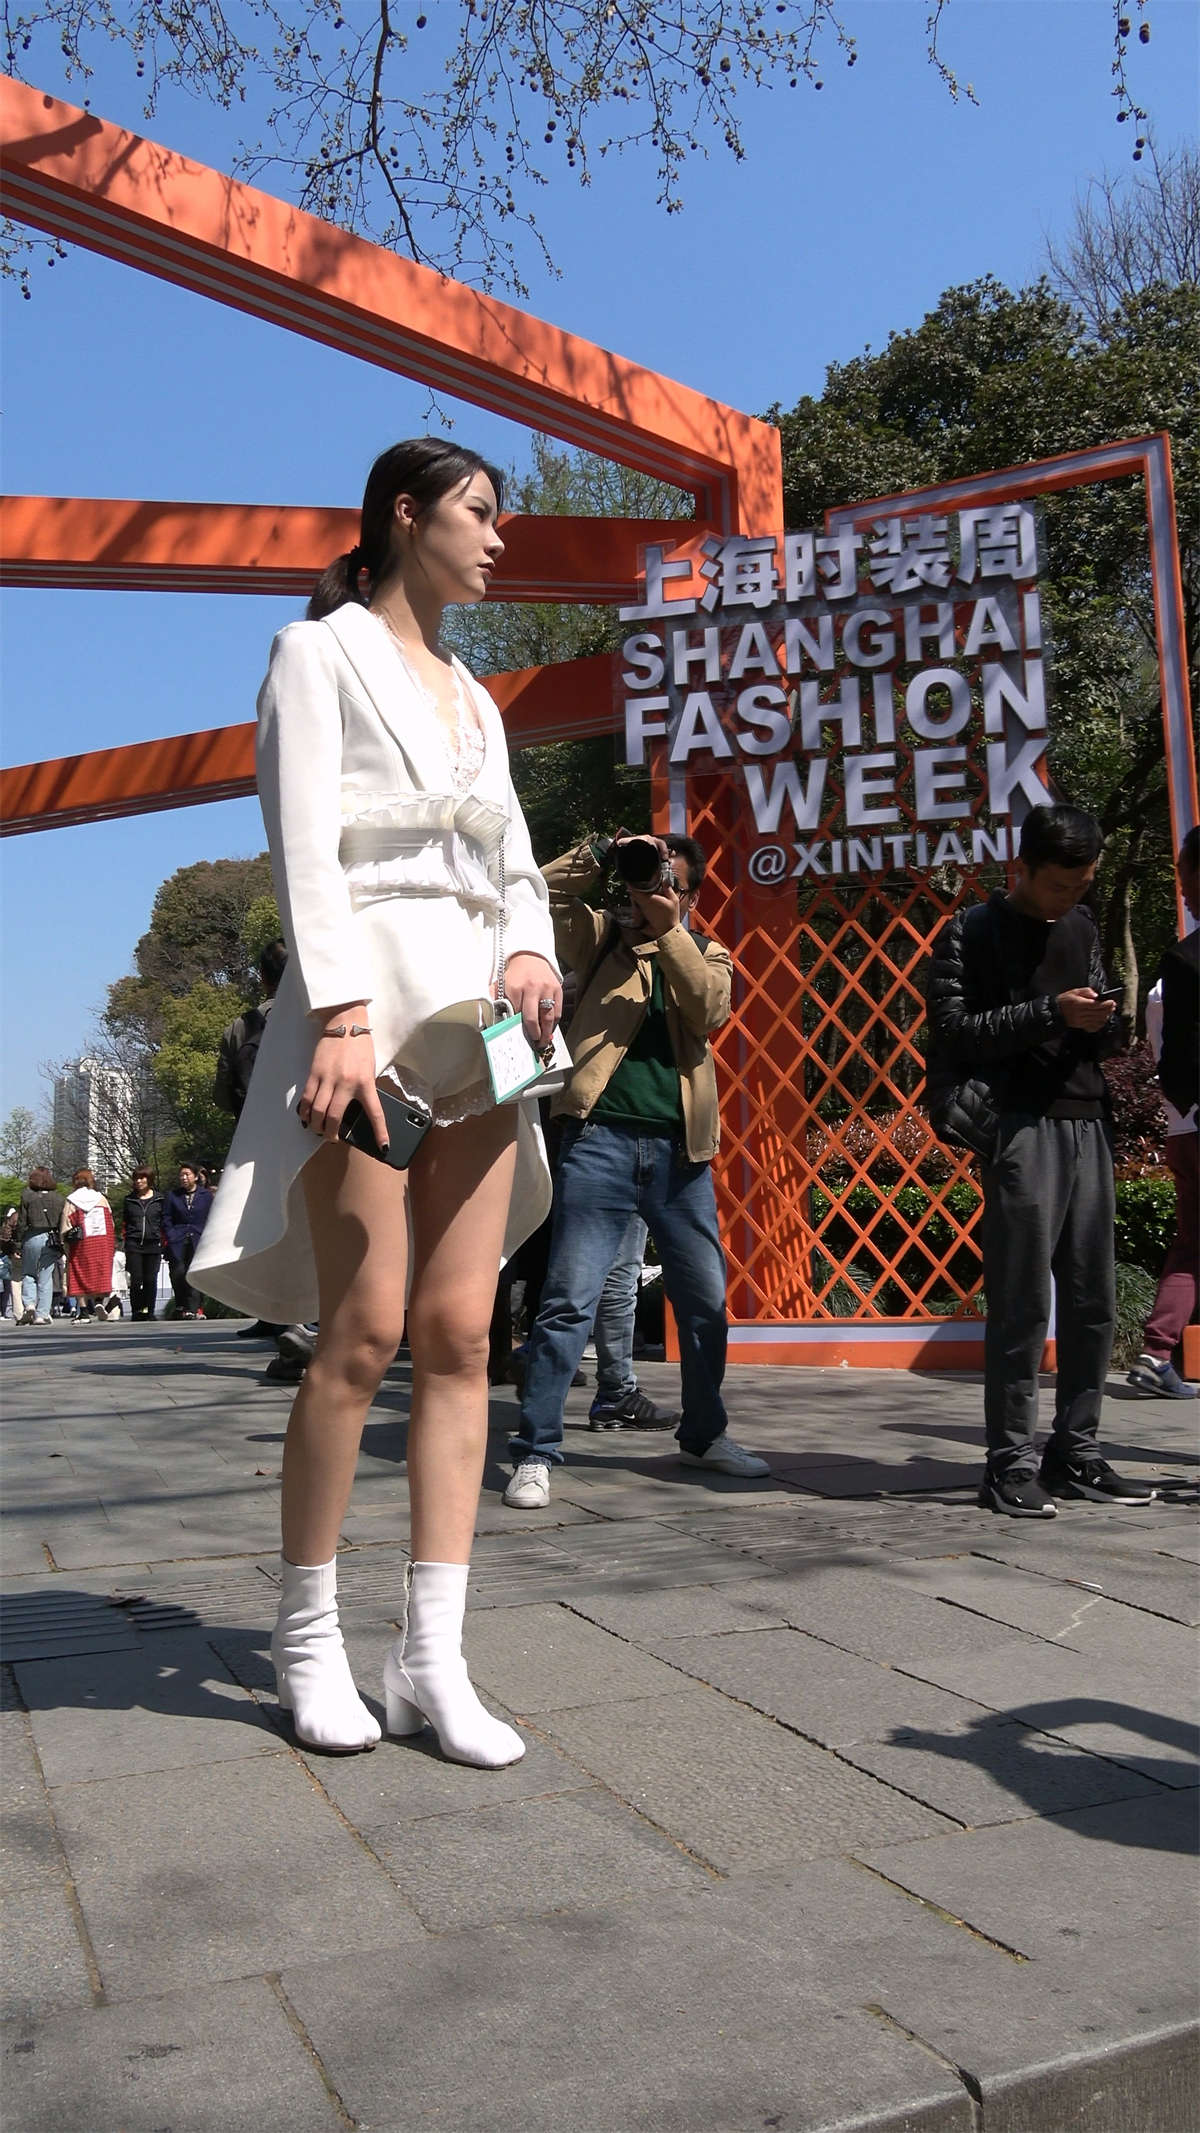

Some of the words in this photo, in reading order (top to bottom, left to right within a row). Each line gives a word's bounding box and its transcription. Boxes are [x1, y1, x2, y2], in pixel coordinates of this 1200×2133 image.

[619, 502, 1038, 622] 上海时装周
[622, 591, 1042, 690] SHANGHAI
[625, 658, 1046, 766] FASHION
[743, 737, 1054, 834] WEEK
